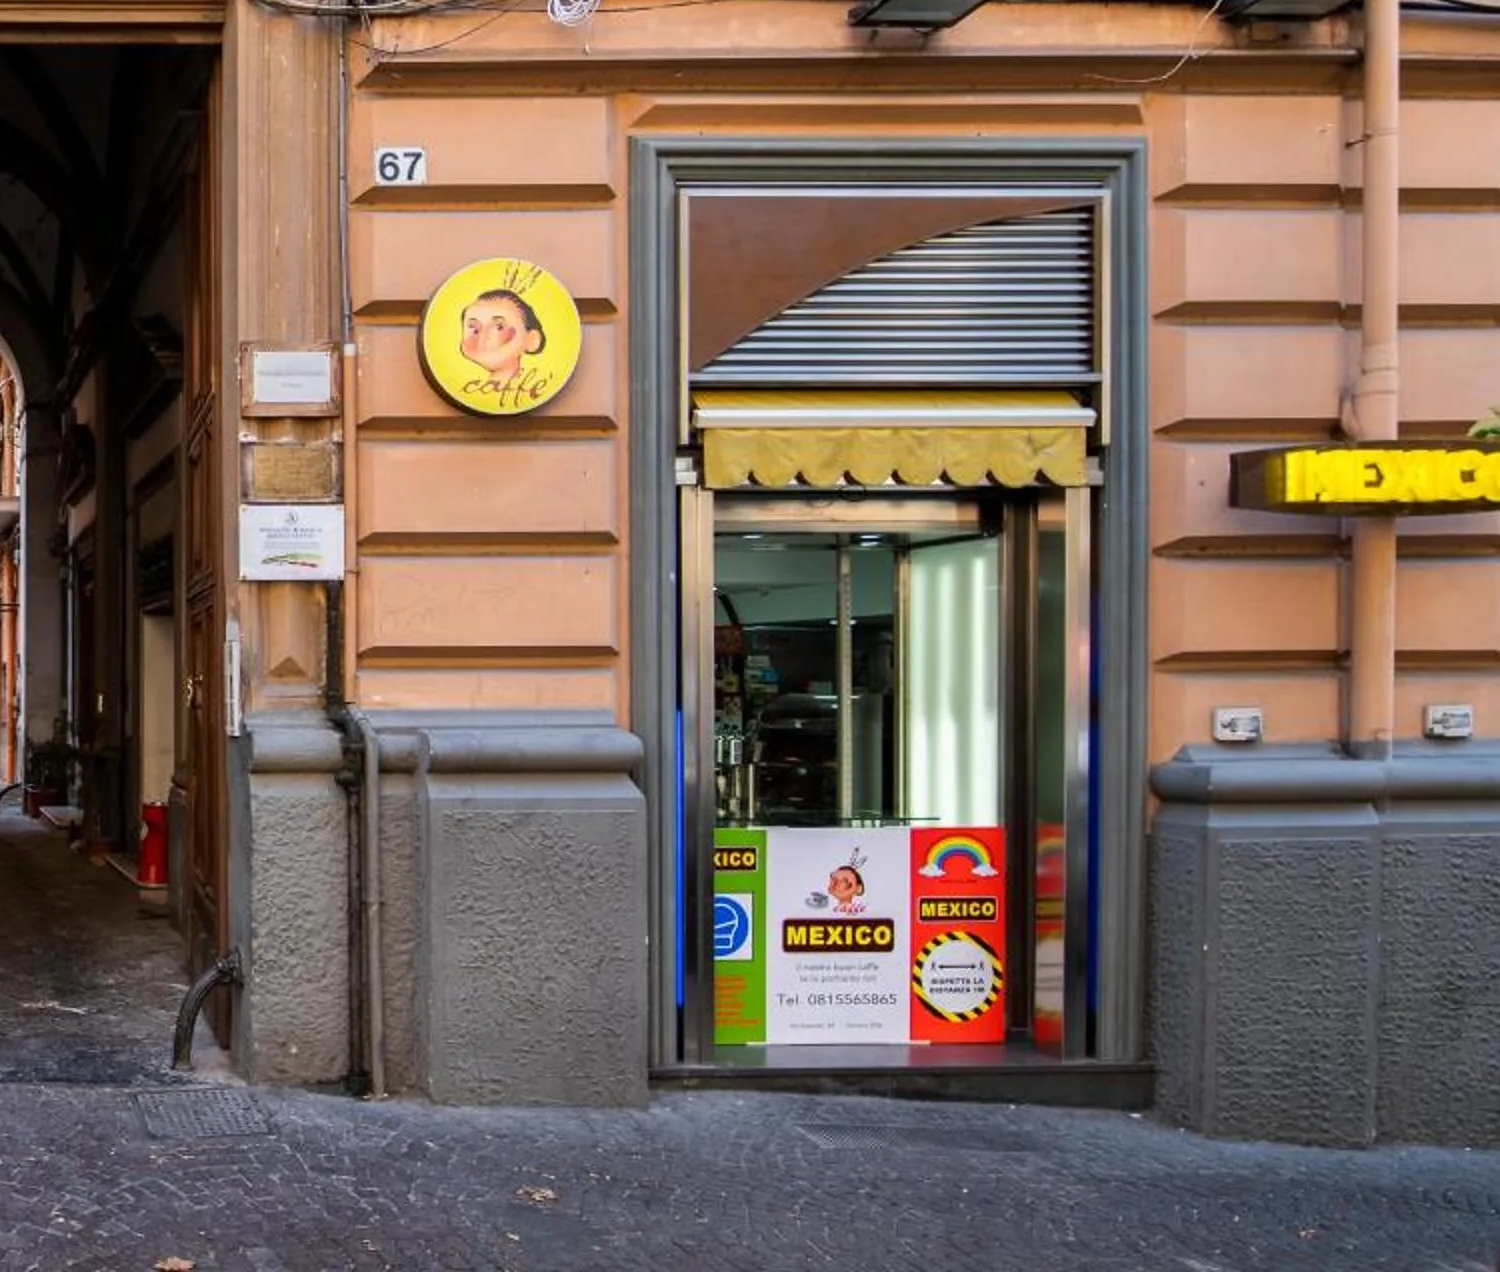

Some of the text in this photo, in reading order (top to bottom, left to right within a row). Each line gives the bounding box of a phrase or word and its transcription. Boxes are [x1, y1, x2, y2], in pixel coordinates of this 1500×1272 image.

[378, 151, 423, 181] 67
[713, 851, 755, 867] XICO
[921, 901, 995, 917] MEXICO
[786, 924, 892, 946] MEXICO
[807, 993, 898, 1006] 0815565865
